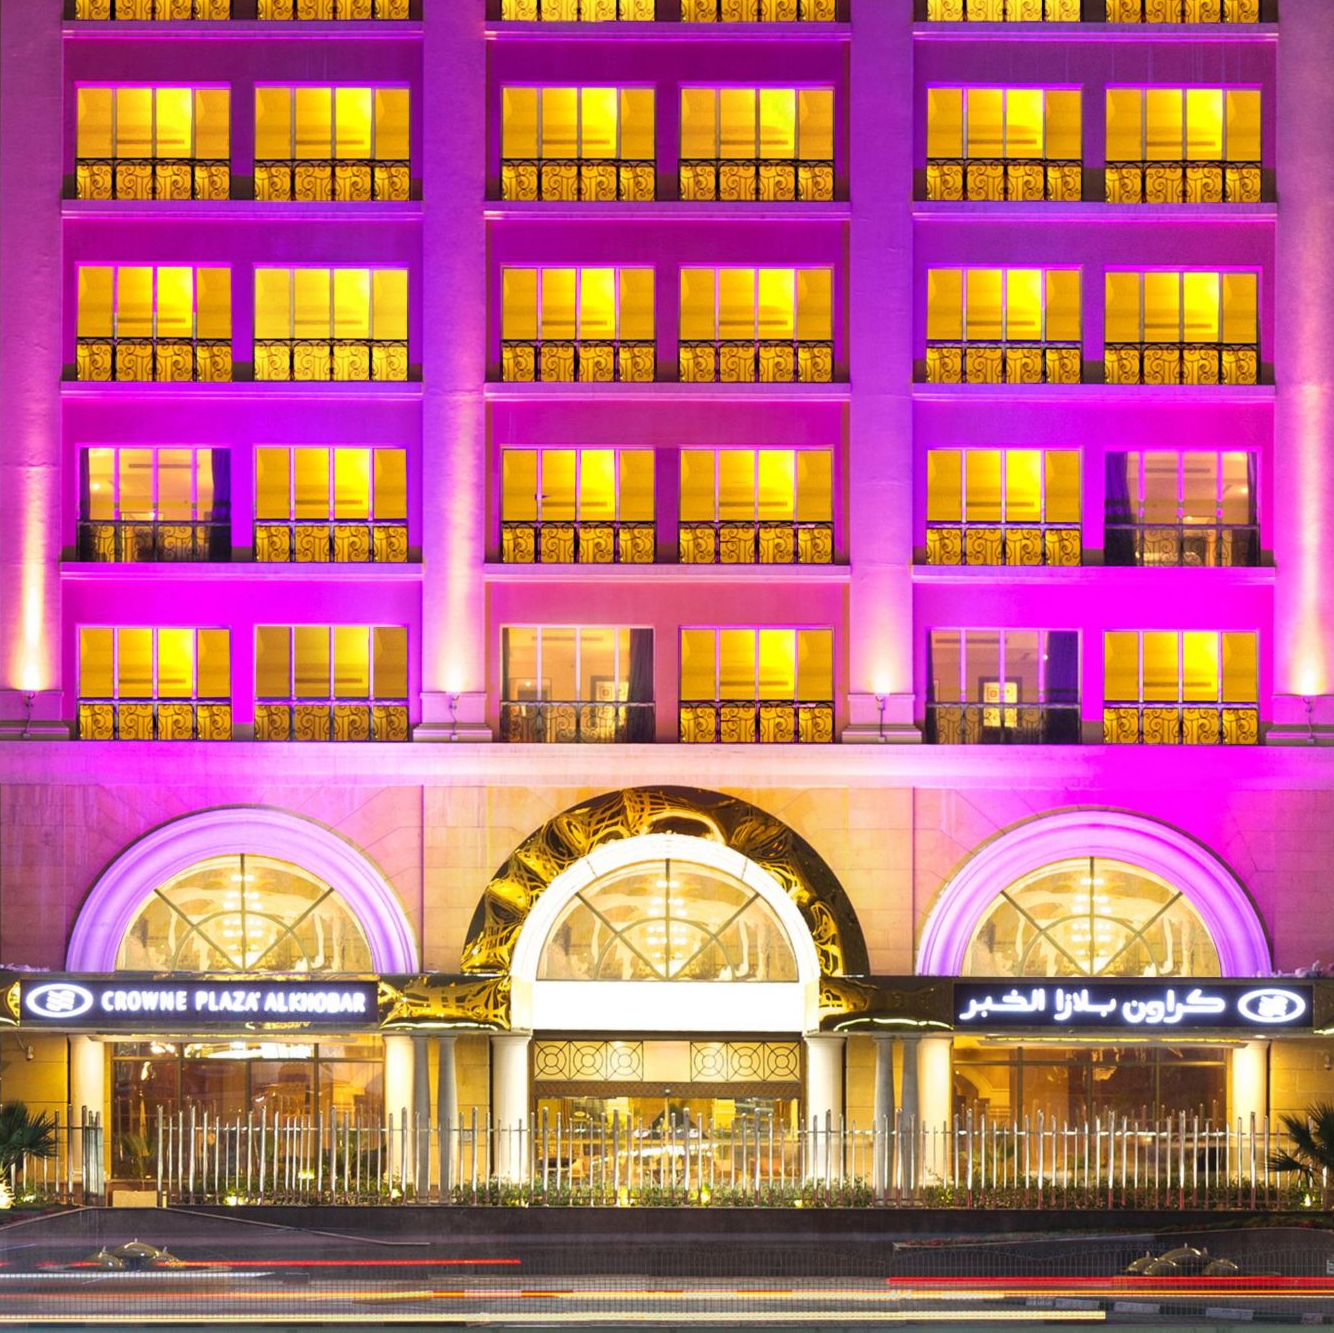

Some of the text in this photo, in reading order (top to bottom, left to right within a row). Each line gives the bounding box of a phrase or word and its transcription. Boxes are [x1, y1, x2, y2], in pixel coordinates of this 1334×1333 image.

[100, 989, 188, 1012] CROWNE
[263, 991, 366, 1014] ALKHOBAR
[958, 988, 1227, 1024] كراون بلازا الخبر
